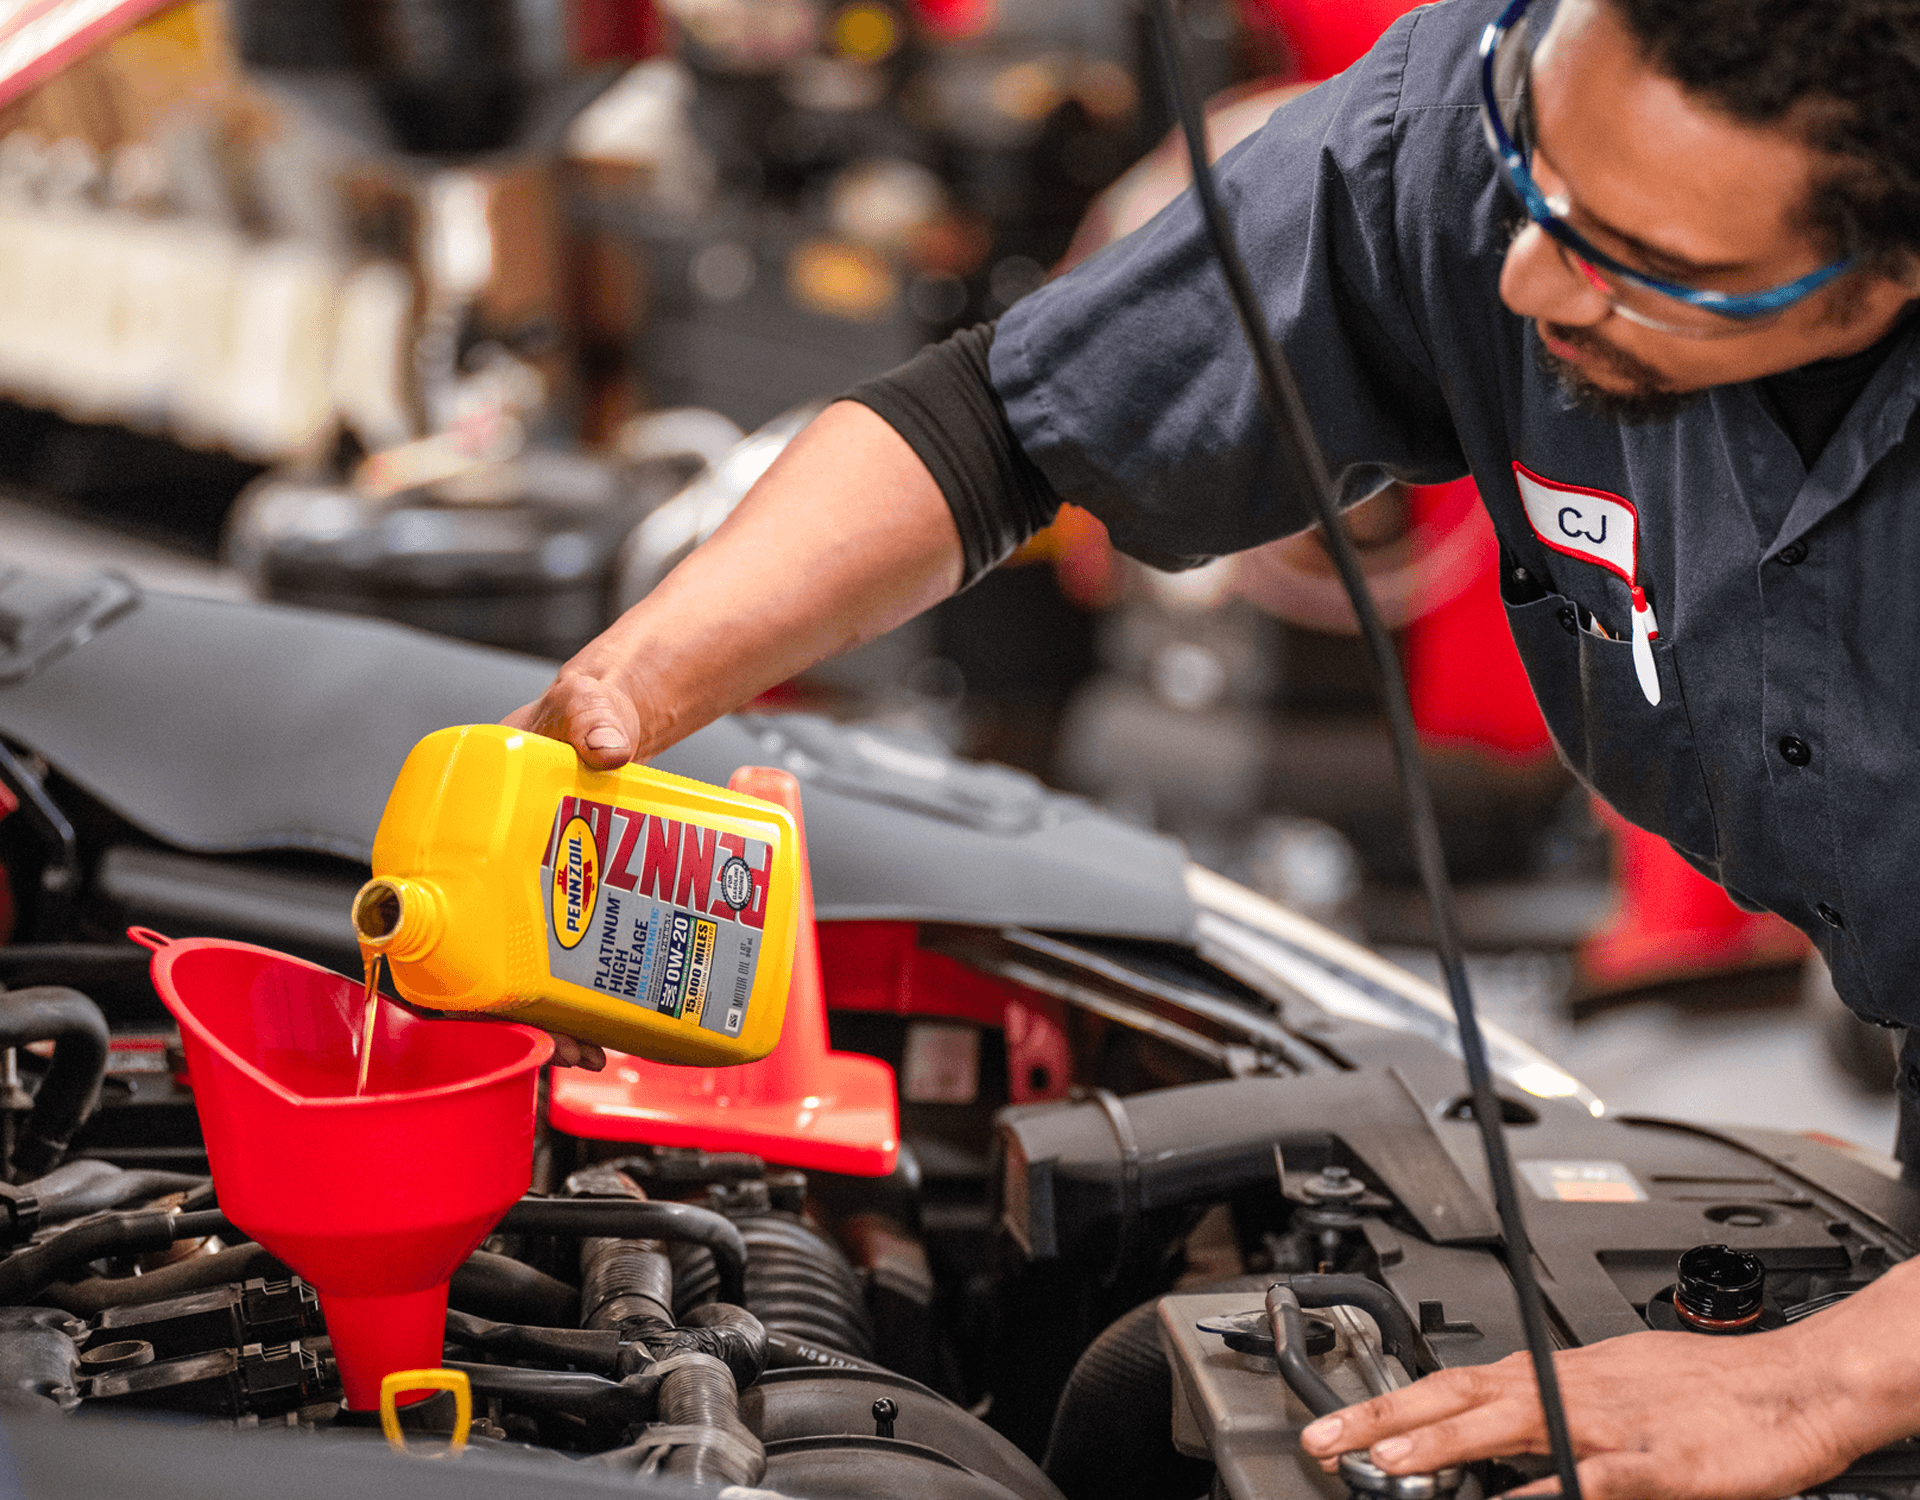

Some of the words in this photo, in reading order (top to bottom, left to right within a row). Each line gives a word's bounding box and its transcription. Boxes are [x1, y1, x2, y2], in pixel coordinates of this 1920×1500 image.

[1558, 507, 1606, 544] CJ
[565, 836, 582, 933] PENNZOIL
[594, 897, 621, 990] PLATINUM
[623, 918, 649, 997] MILEAGE
[643, 907, 660, 970] SYNTHETIC
[666, 917, 688, 982] 0W-20
[609, 948, 629, 993] HIGH
[638, 975, 649, 1000] FULL
[684, 968, 702, 1014] 15,000
[694, 924, 708, 966] MILES
[738, 961, 751, 975] OIL
[660, 983, 678, 1008] SAE
[695, 973, 708, 1015] PROTECTION
[732, 976, 748, 1008] MOTOR
